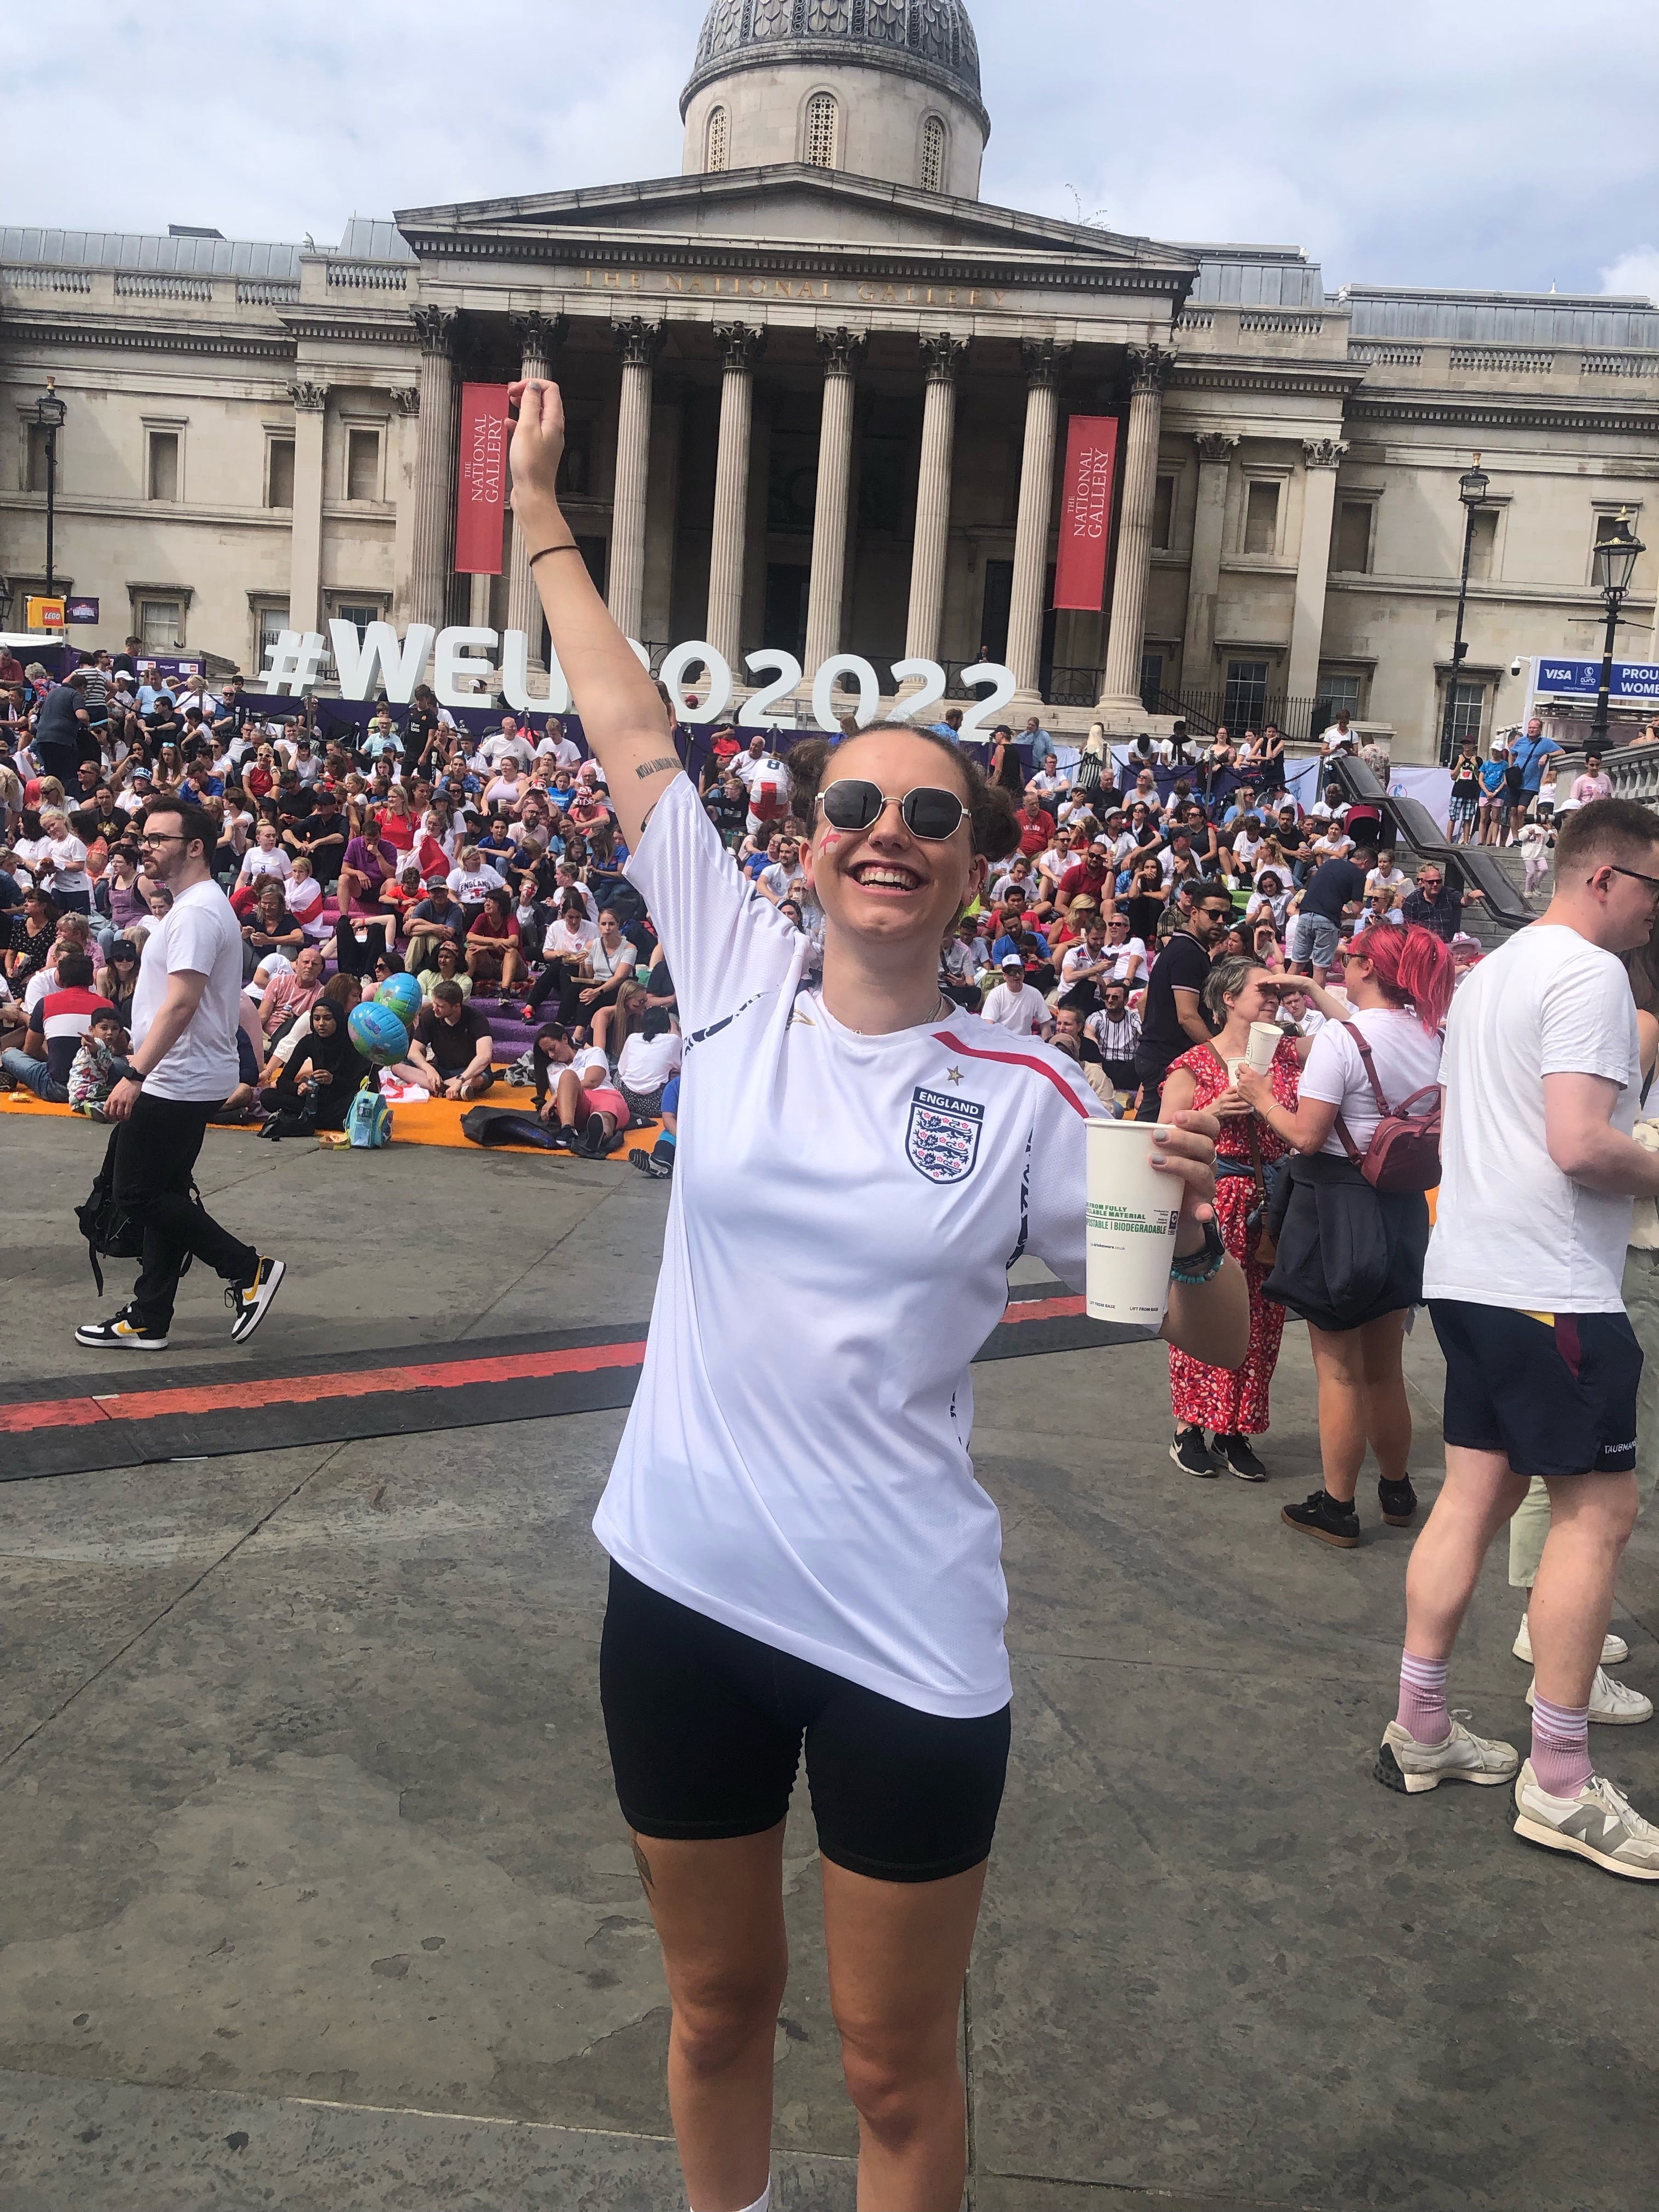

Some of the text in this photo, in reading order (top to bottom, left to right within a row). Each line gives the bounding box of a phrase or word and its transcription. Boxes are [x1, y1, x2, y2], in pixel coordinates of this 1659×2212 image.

[583, 270, 1007, 308] THE NATIONAL GALLERY
[471, 414, 487, 502] NATIONAL
[485, 414, 503, 503] GALLERY
[1074, 447, 1093, 537] NATIONAL
[1088, 448, 1108, 538] GALLERY
[1067, 495, 1075, 514] THE
[1544, 668, 1571, 680] VISA
[1622, 668, 1659, 680] PROU
[767, 760, 781, 770] 8
[261, 865, 266, 874] 8
[460, 879, 491, 893] ENGLAND
[918, 1091, 979, 1115] ENGLAND
[1109, 1211, 1147, 1220] MATERIAL
[1114, 1222, 1167, 1234] BIODEGRADABLE
